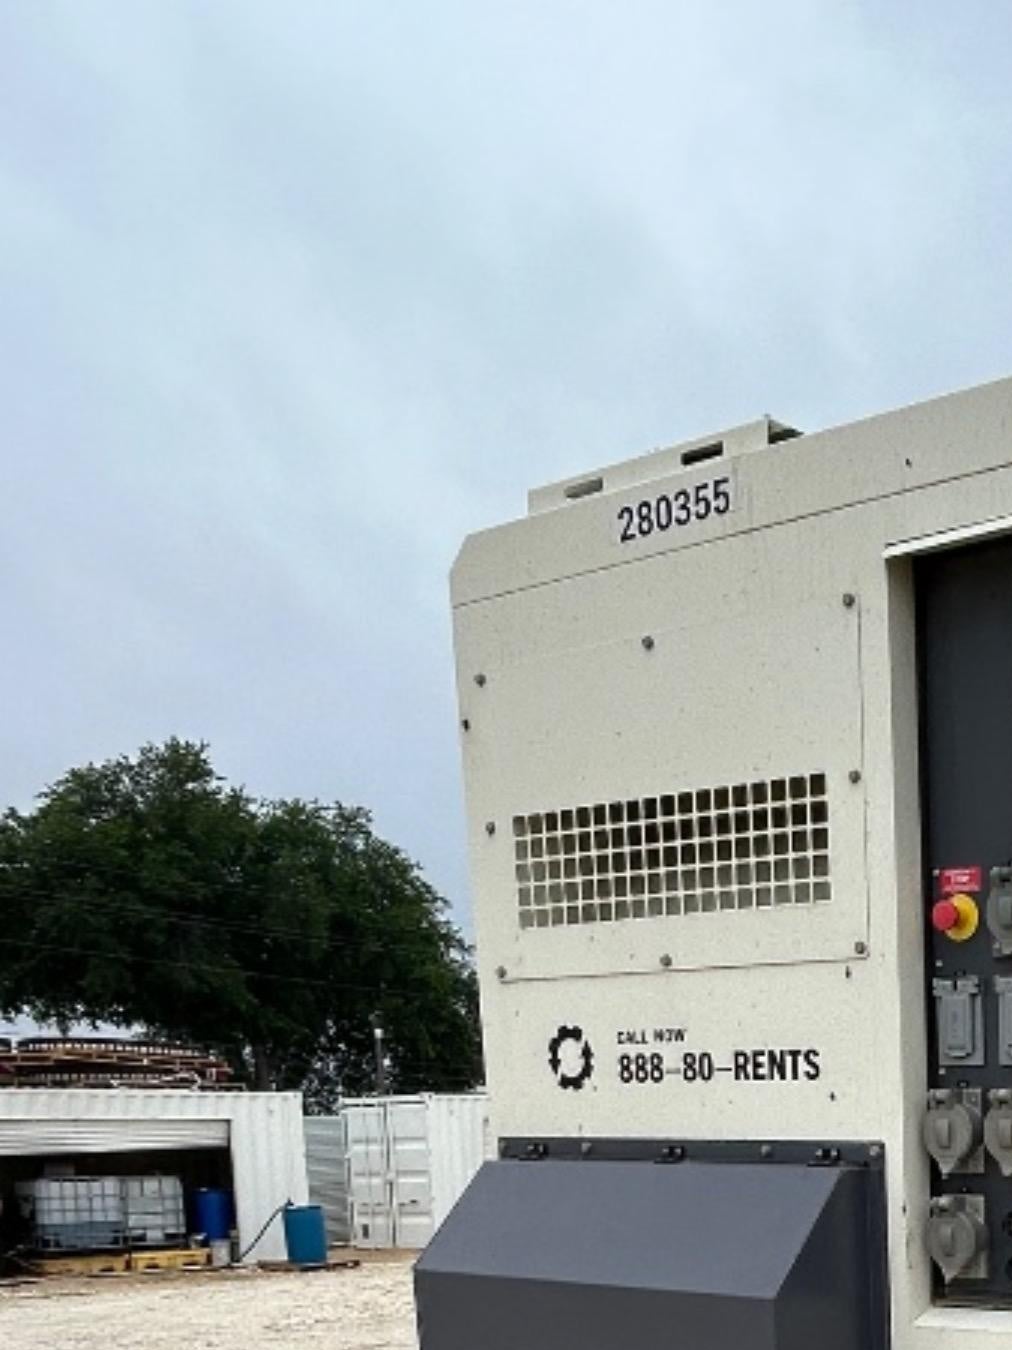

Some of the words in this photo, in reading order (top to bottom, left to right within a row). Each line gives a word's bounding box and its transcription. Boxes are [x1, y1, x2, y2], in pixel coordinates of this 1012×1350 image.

[617, 477, 730, 543] 280355
[617, 1031, 648, 1045] CALL
[618, 1049, 820, 1083] 888-80-RENTS
